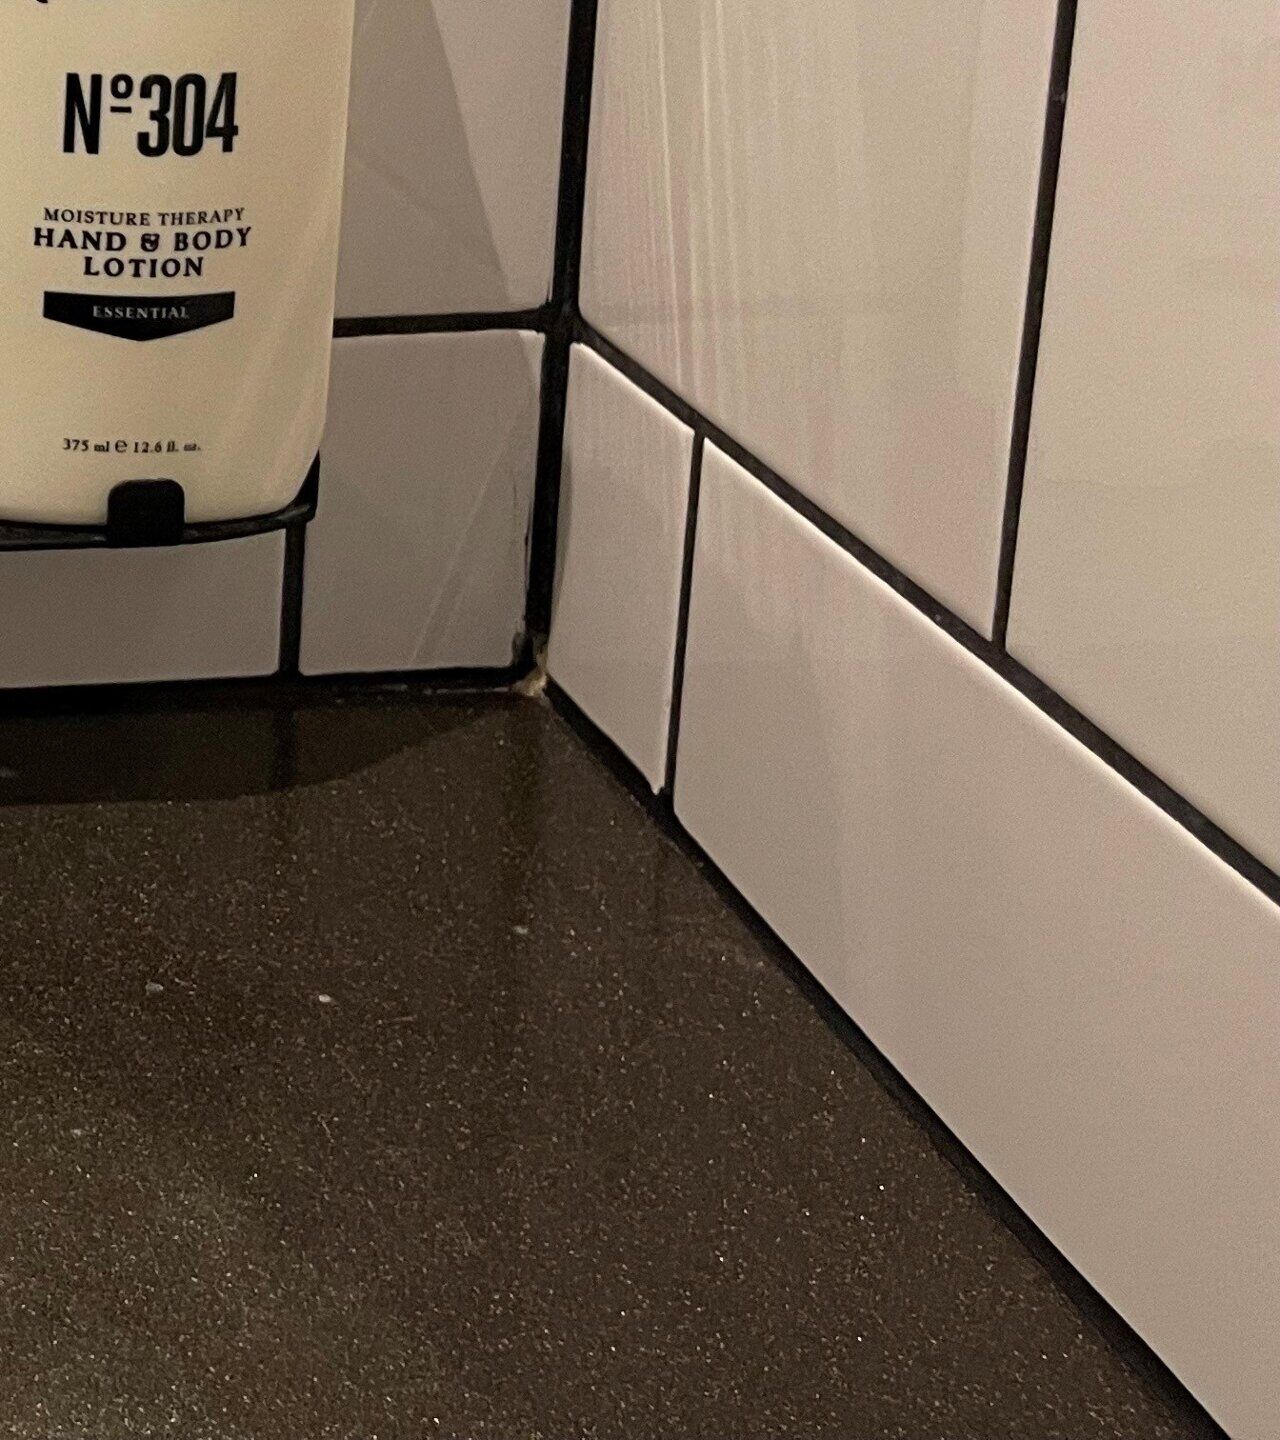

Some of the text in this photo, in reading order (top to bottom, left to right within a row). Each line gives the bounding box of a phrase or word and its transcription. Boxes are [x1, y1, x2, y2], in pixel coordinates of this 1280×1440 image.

[43, 207, 245, 226] MOISTURE THERAPY
[34, 226, 252, 252] HAND & BODY
[83, 256, 203, 278] LOTION
[92, 305, 190, 319] ESSENTIAL
[62, 438, 90, 452] 375
[94, 441, 110, 453] ml
[133, 441, 162, 453] 12.6
